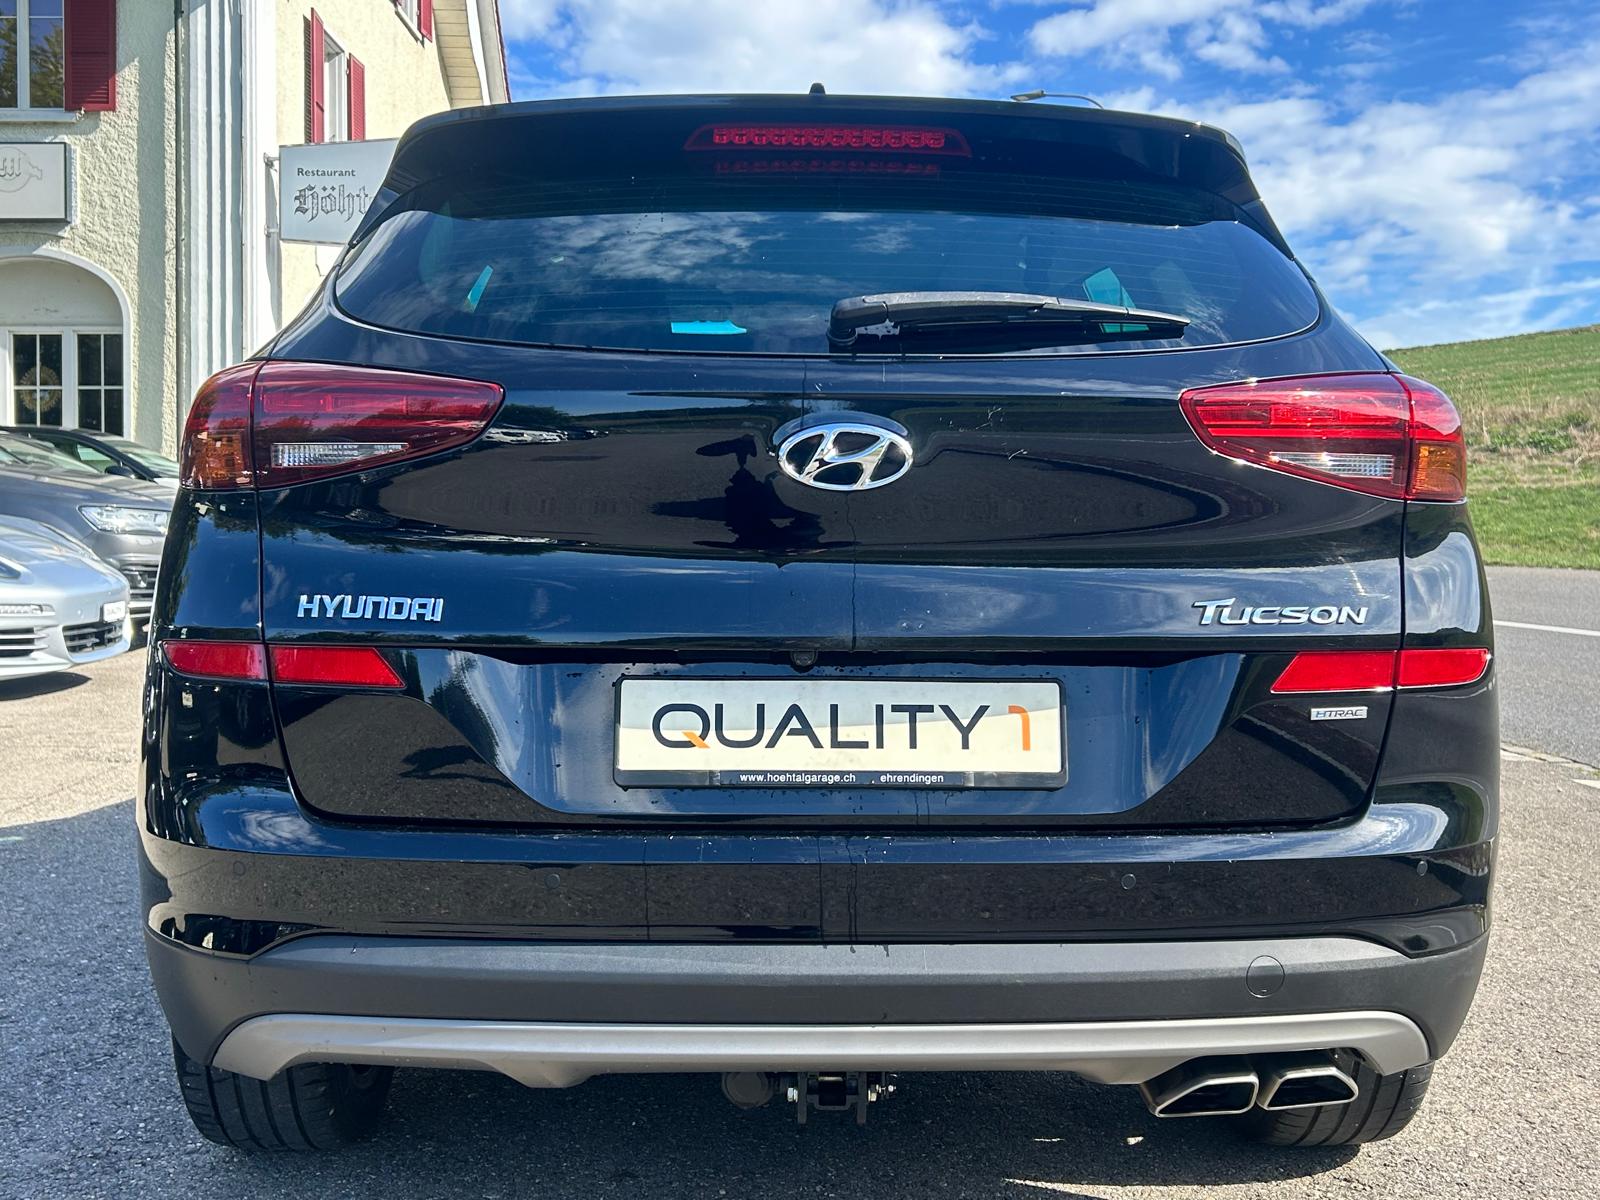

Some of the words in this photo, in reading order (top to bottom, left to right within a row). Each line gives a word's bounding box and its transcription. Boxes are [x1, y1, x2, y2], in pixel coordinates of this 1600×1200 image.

[297, 167, 356, 177] Restaurant
[294, 184, 372, 224] Höht
[297, 594, 444, 622] HYUNDAI
[1315, 709, 1366, 718] HTRAC
[739, 773, 856, 785] www.hoehtalgarage.ch
[880, 774, 944, 785] ehrendingen
